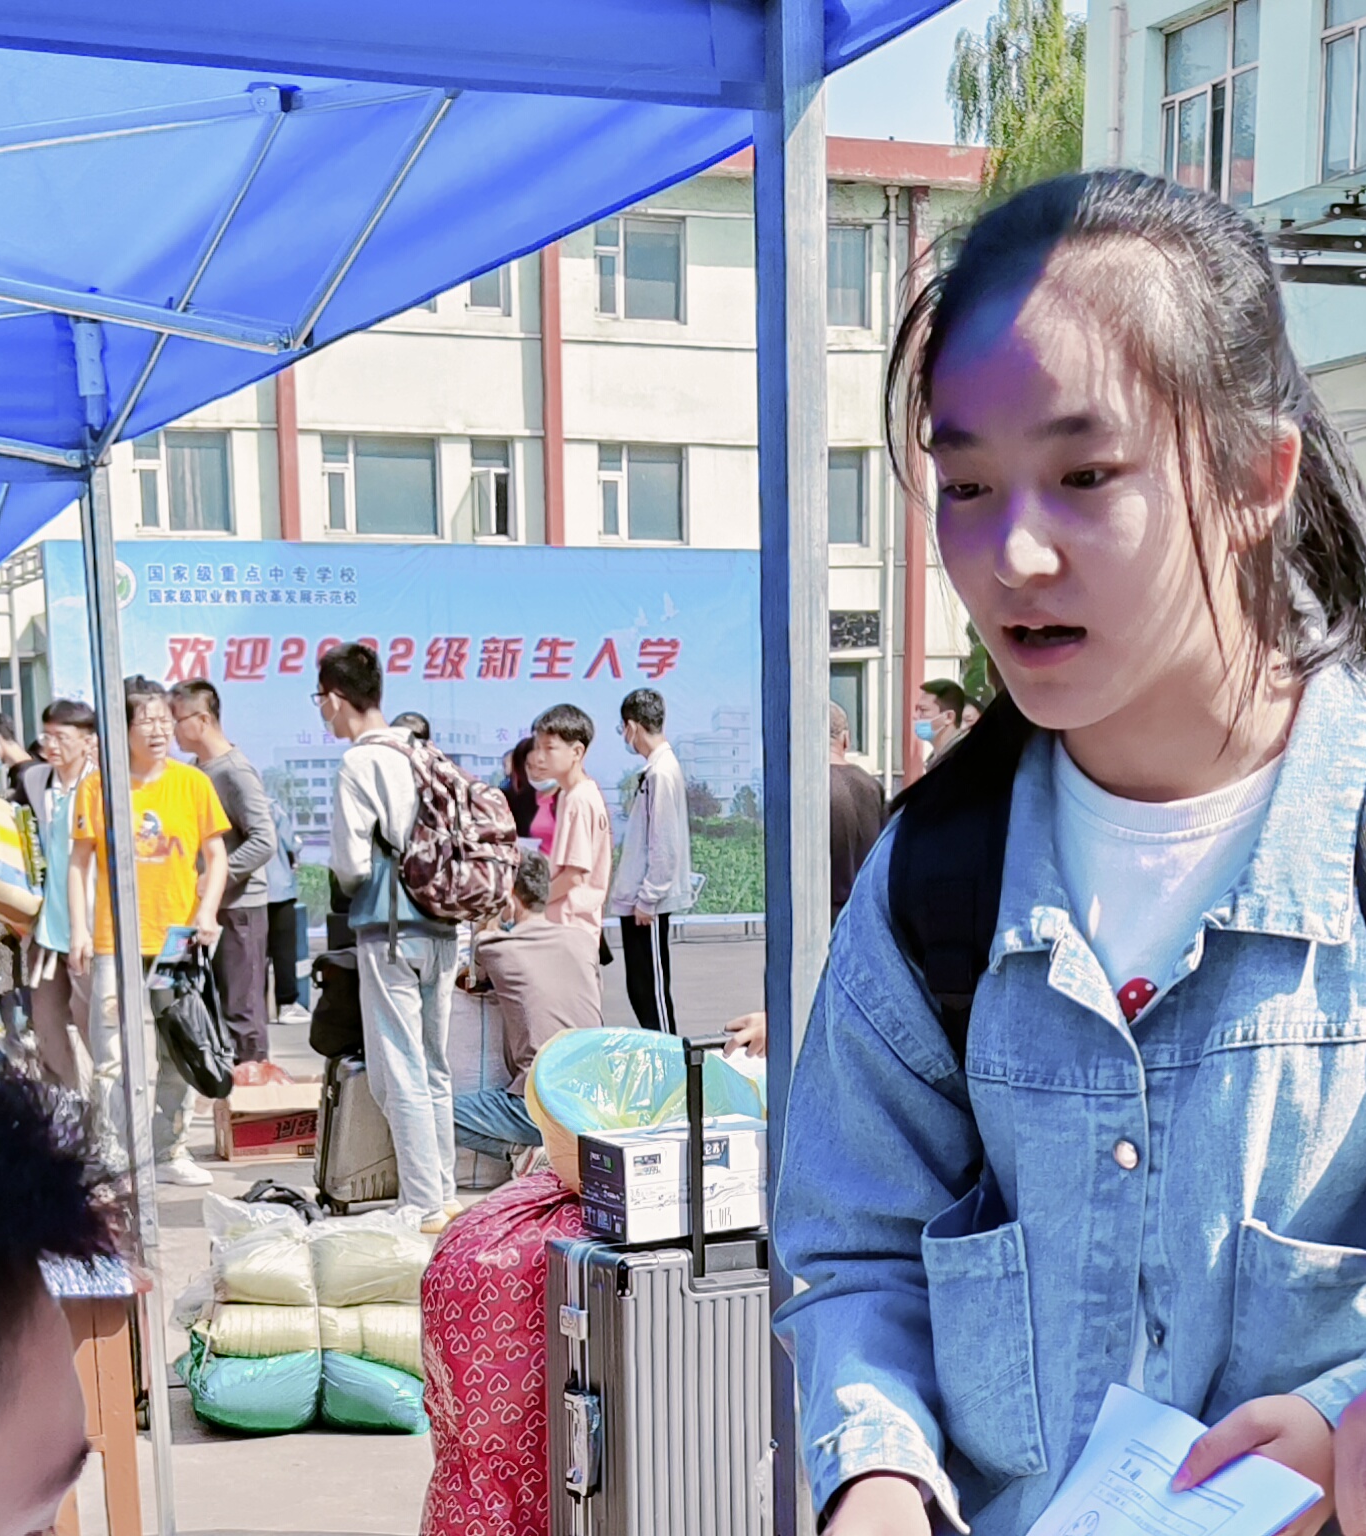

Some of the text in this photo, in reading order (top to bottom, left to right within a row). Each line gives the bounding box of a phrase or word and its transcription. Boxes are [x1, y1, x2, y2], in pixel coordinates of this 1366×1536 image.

[147, 564, 357, 584] 国家级重点中专学校
[148, 589, 358, 605] 国家级职业教育改革发展示范校
